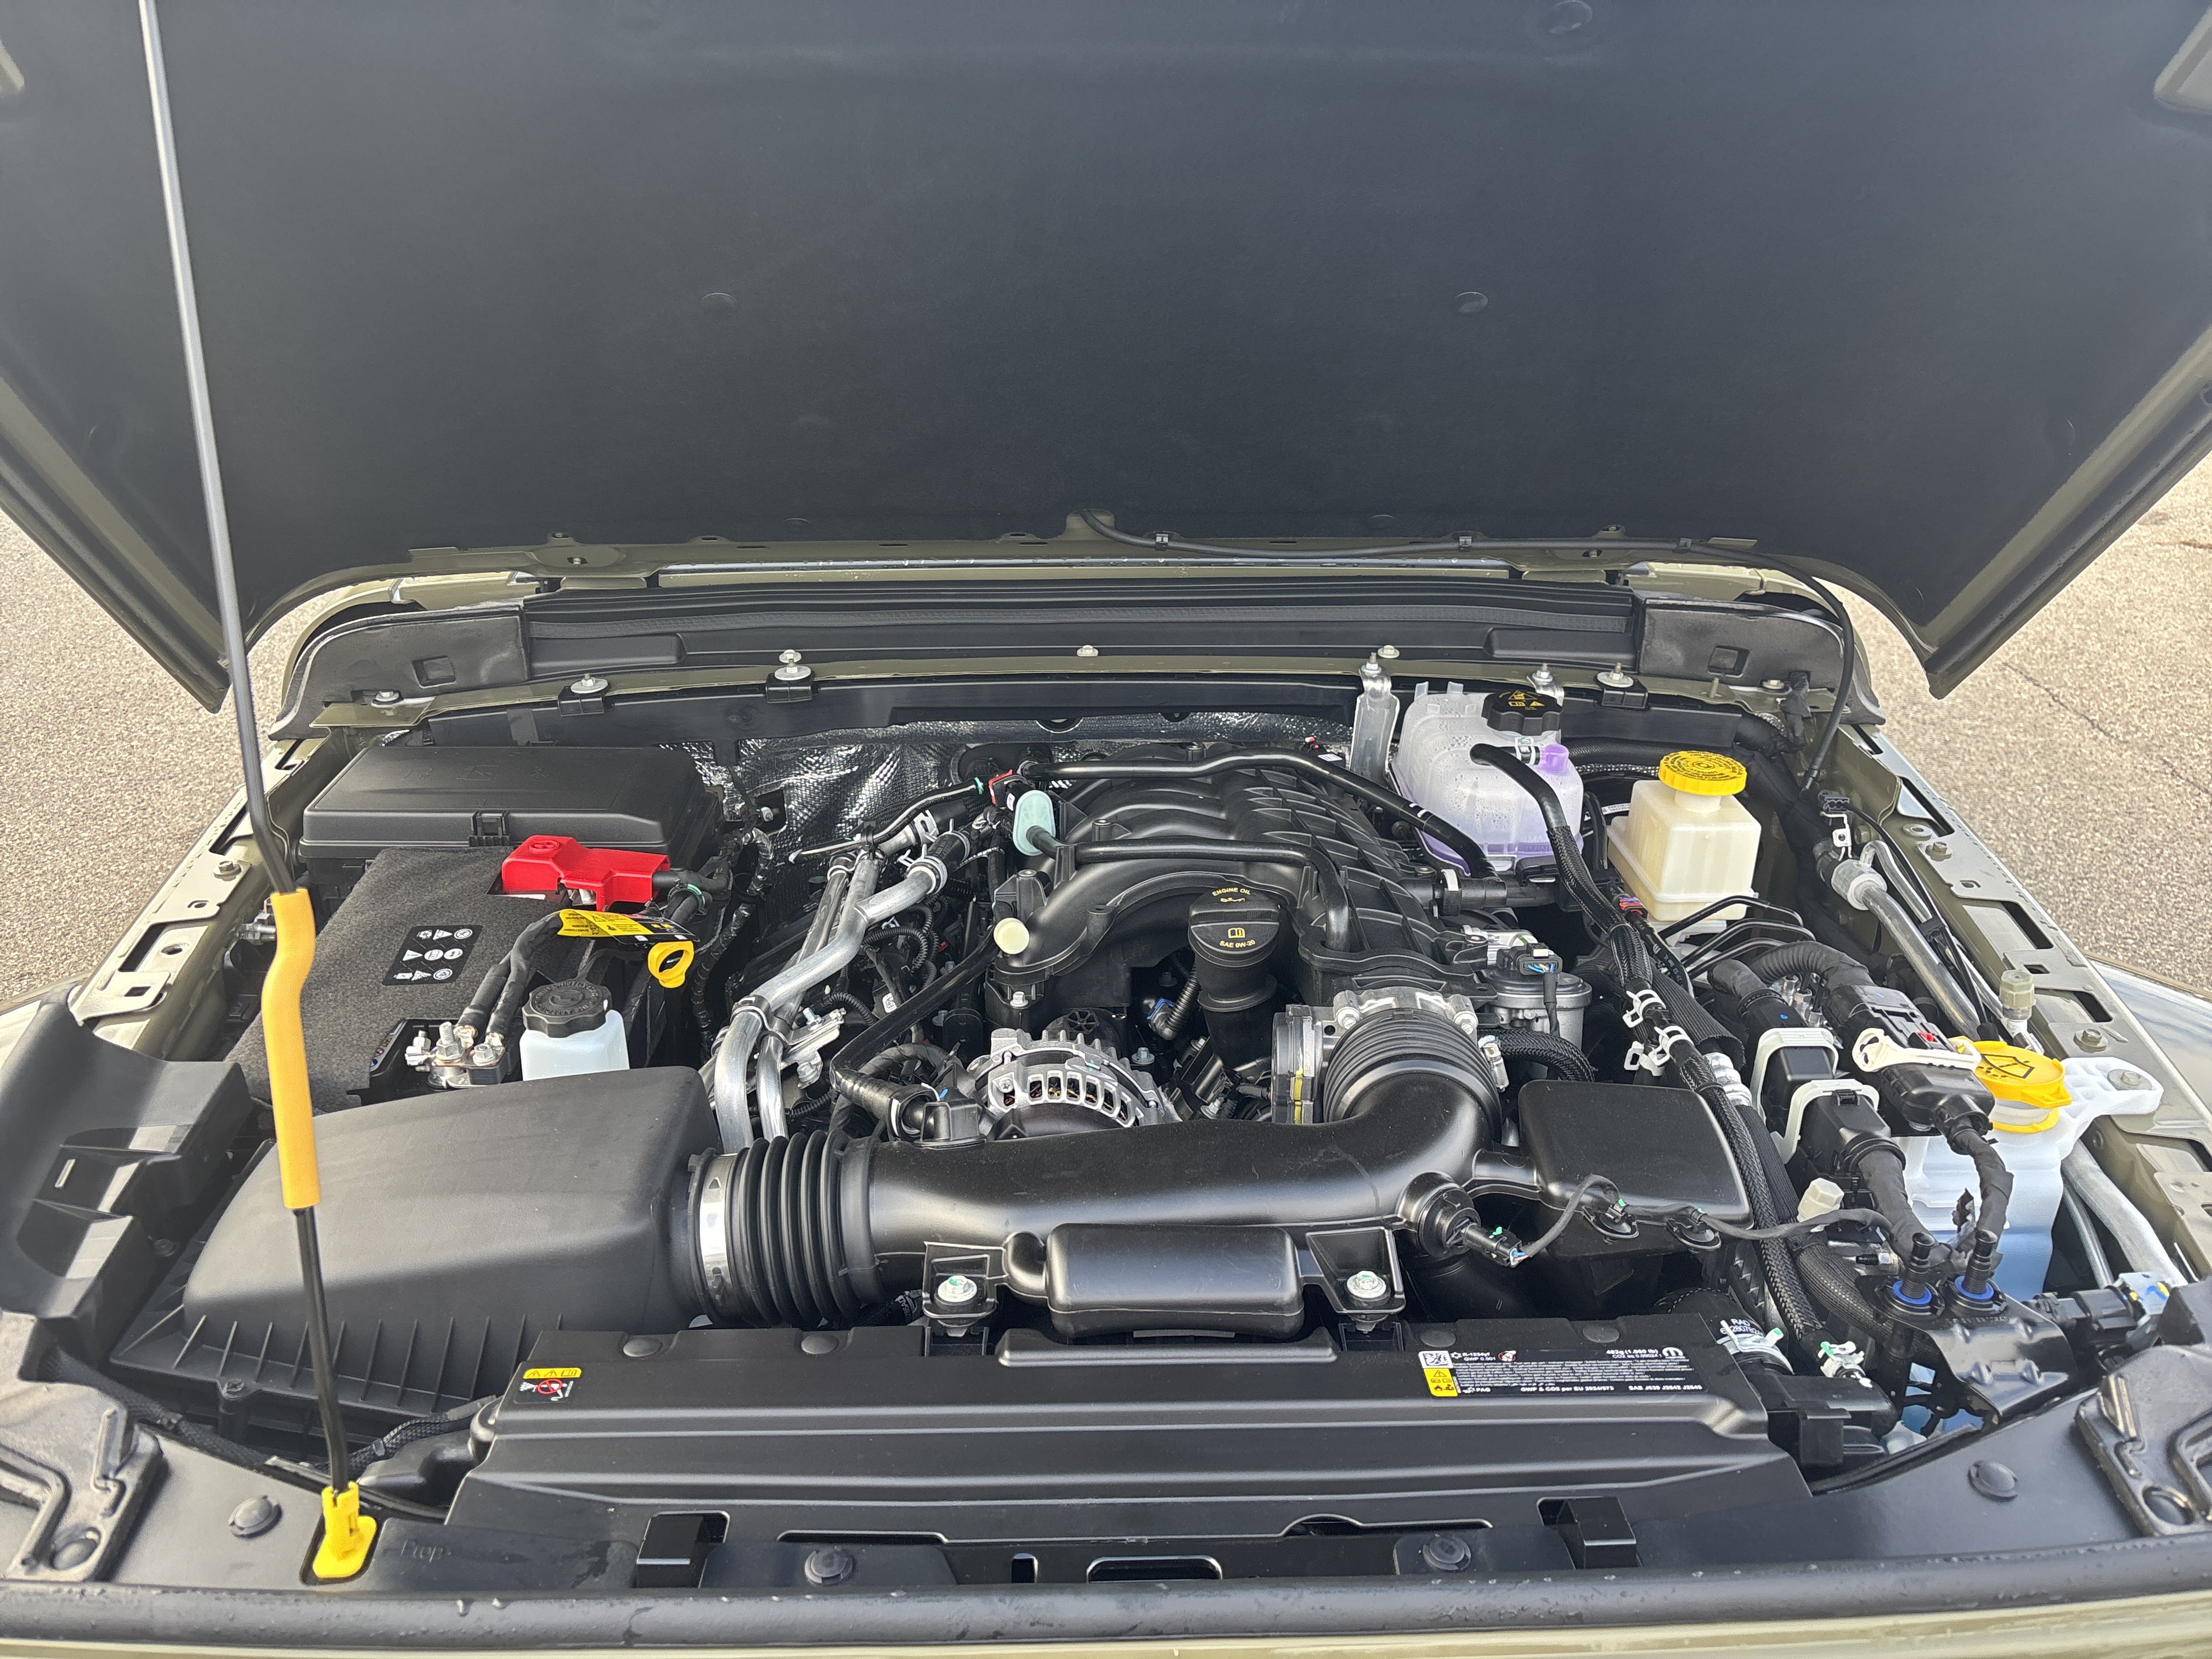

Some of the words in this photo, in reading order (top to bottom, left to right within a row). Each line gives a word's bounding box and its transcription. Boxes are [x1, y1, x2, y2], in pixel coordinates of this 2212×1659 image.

[1212, 888, 1238, 896] ENGINE
[1235, 939, 1256, 948] 0W-20
[1730, 1318, 1751, 1327] RAD
